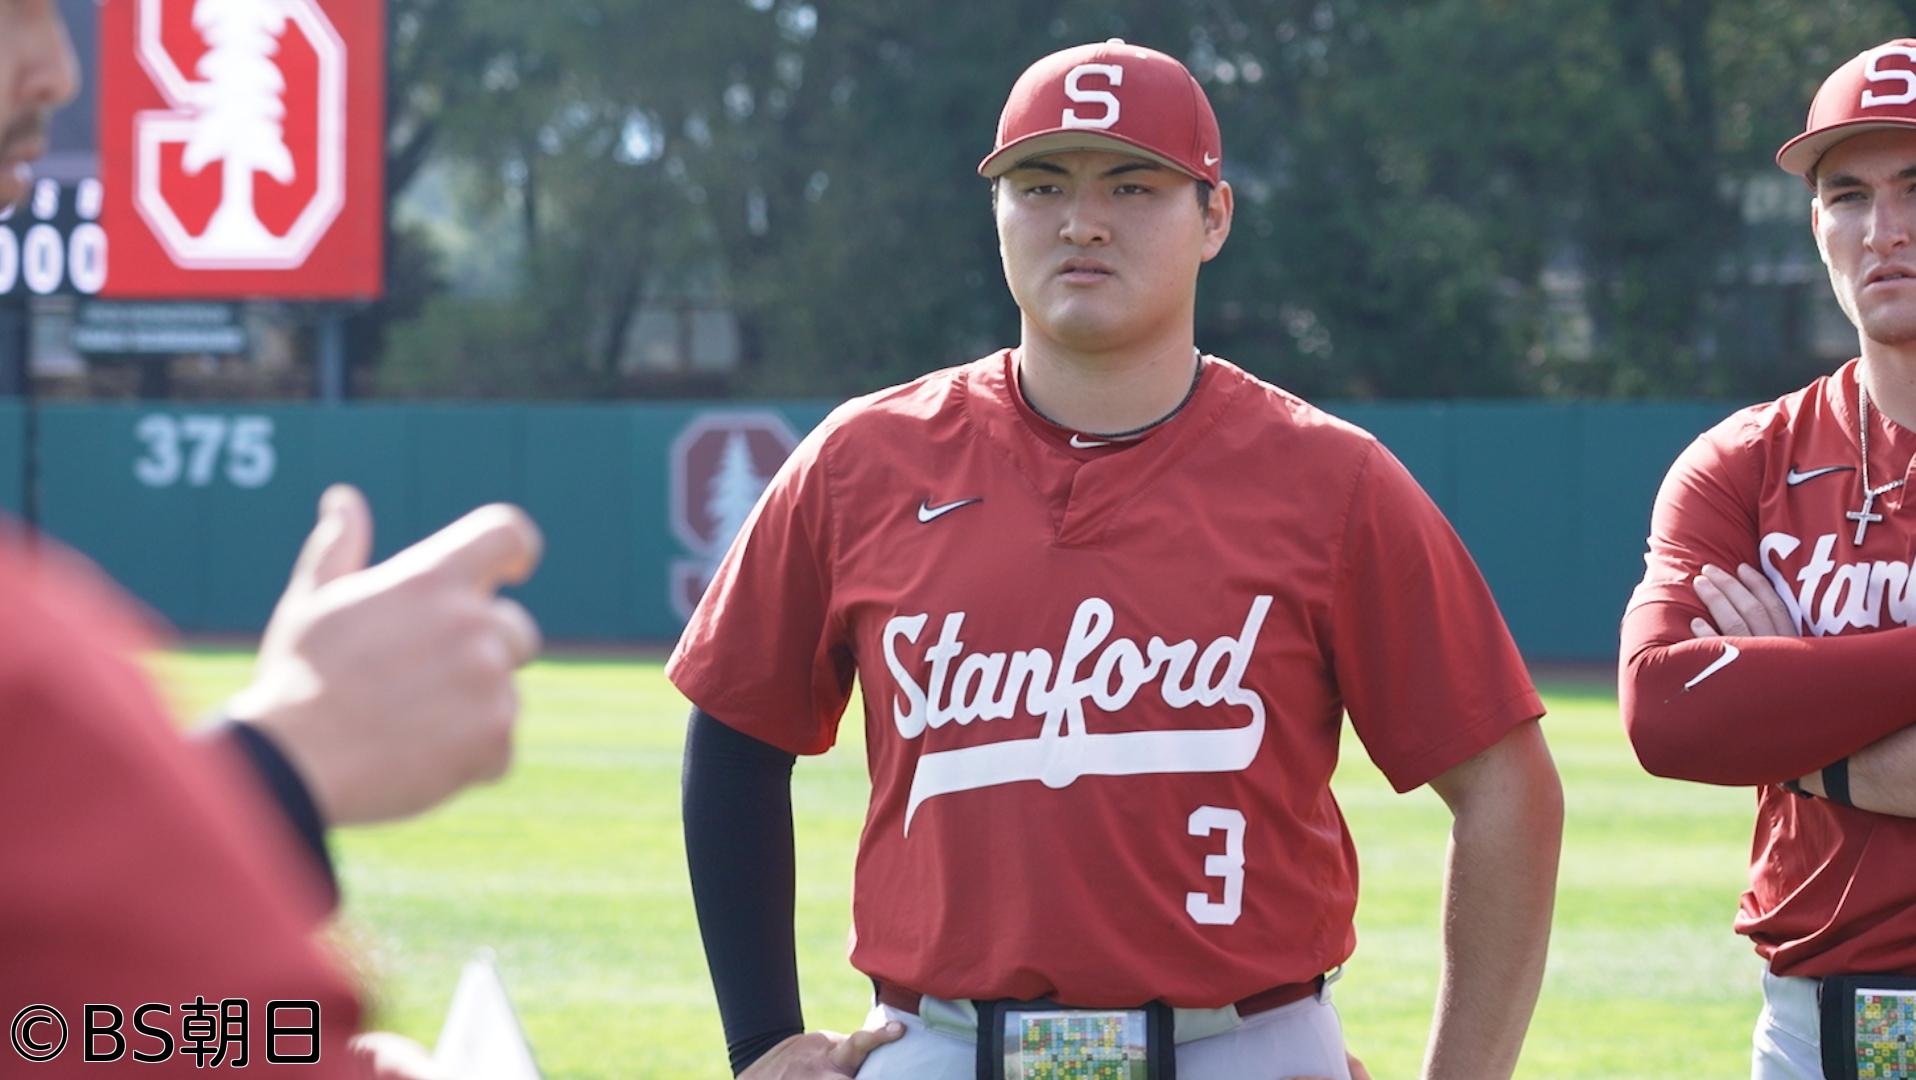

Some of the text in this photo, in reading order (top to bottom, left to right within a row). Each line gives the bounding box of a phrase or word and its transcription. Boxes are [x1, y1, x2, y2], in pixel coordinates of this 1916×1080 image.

[1062, 64, 1123, 129] S
[1861, 45, 1916, 109] S
[134, 413, 276, 488] 375
[1759, 532, 1916, 637] Stan
[882, 594, 1274, 788] Stanford
[1186, 806, 1246, 925] 3
